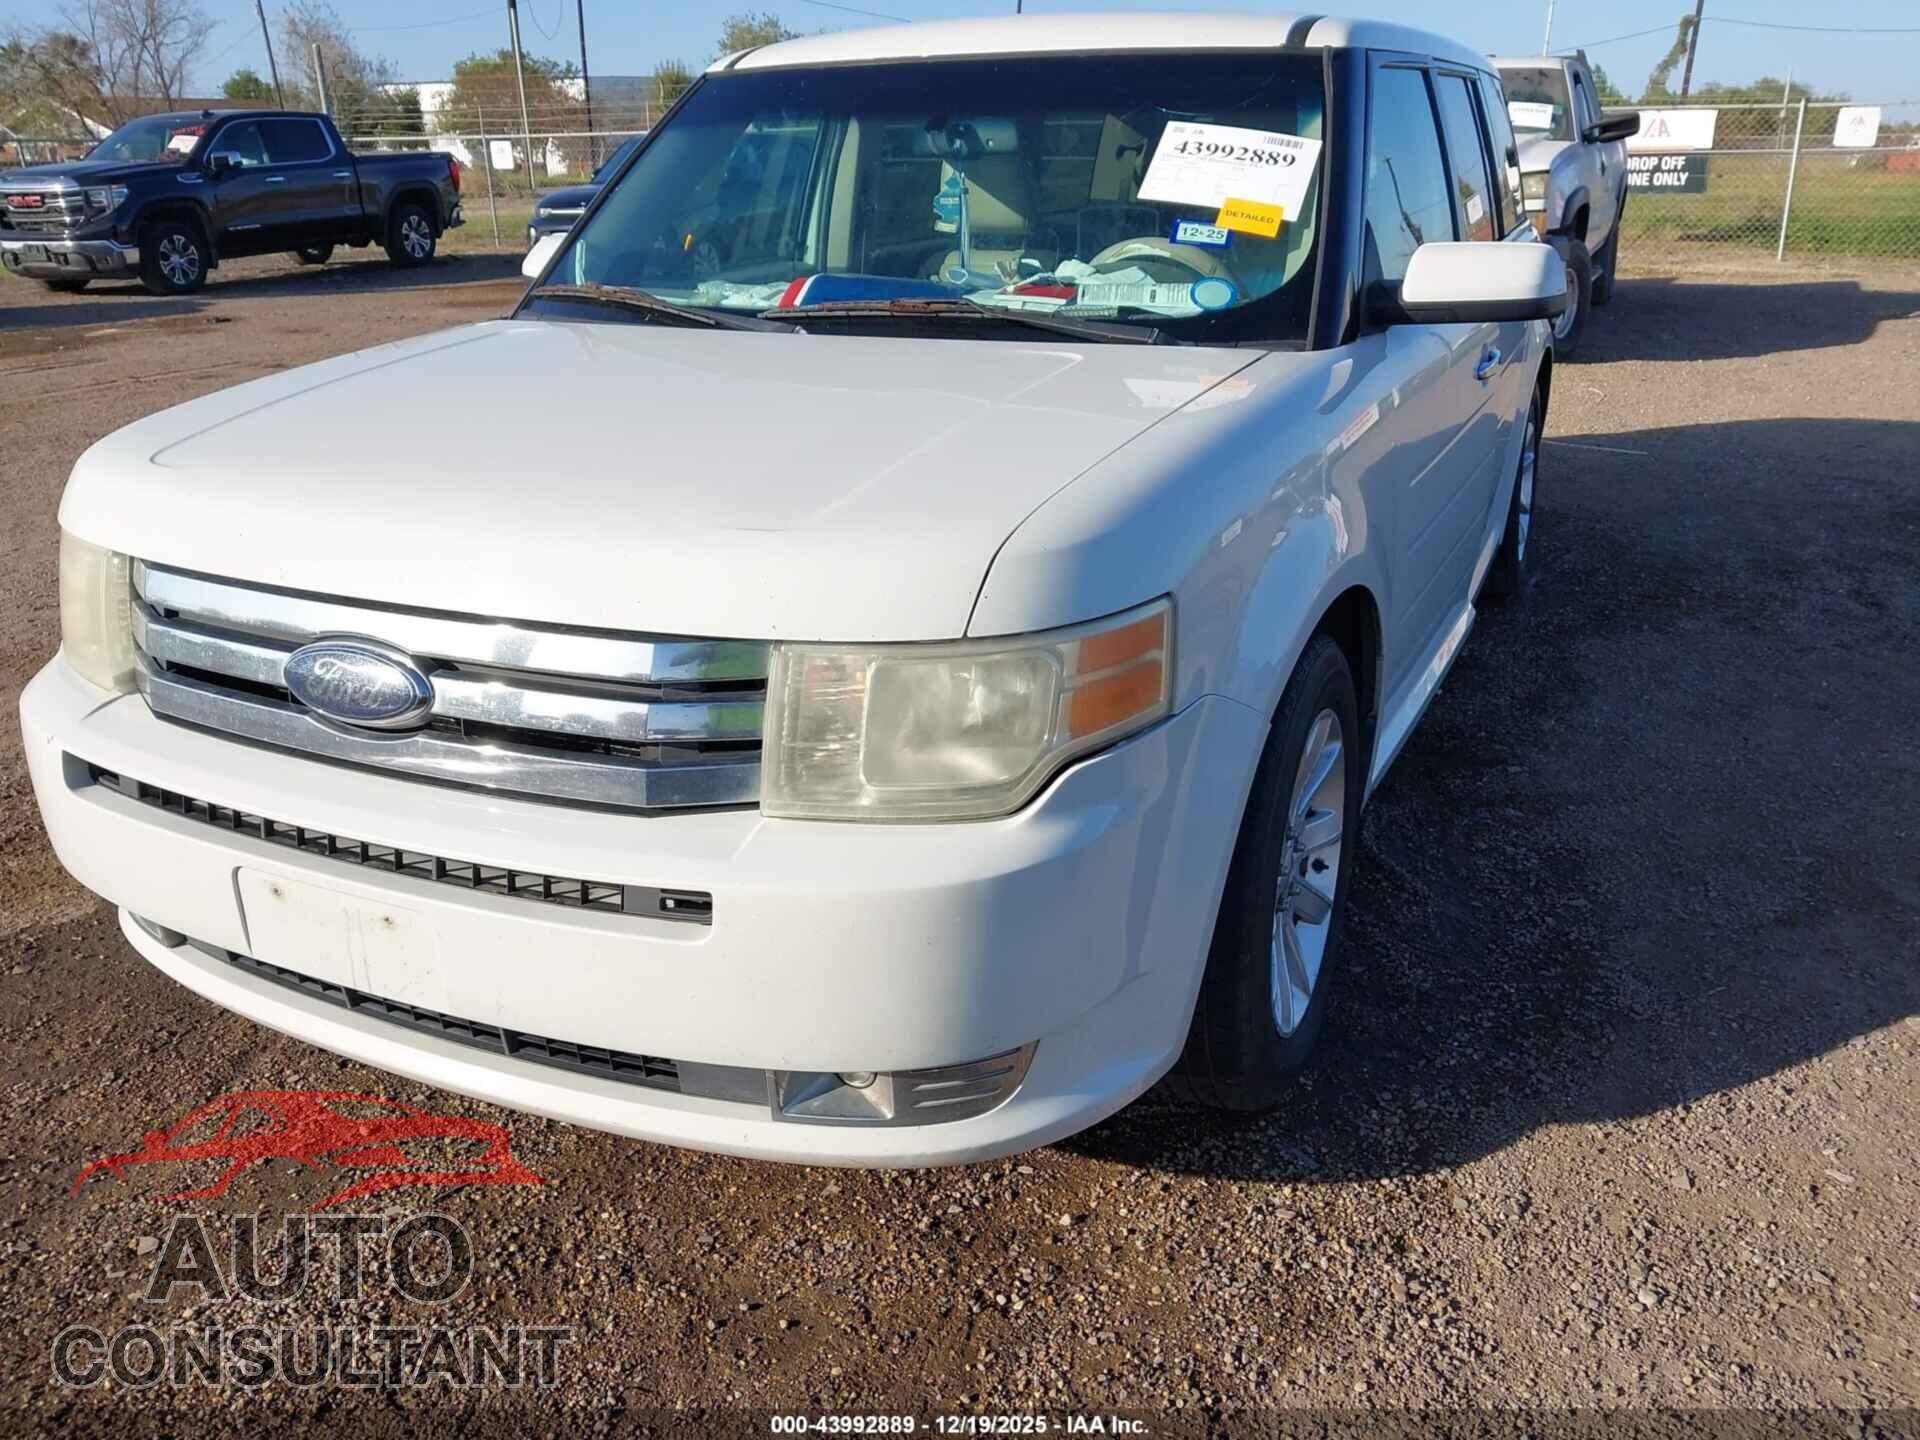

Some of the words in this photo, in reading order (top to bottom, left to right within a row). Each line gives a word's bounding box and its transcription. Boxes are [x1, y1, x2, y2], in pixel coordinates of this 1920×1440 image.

[1174, 139, 1296, 168] 43992889
[1661, 155, 1686, 171] OFF
[1653, 171, 1689, 186] ONLY
[1225, 209, 1275, 225] DETAILED
[306, 657, 388, 709] Ford
